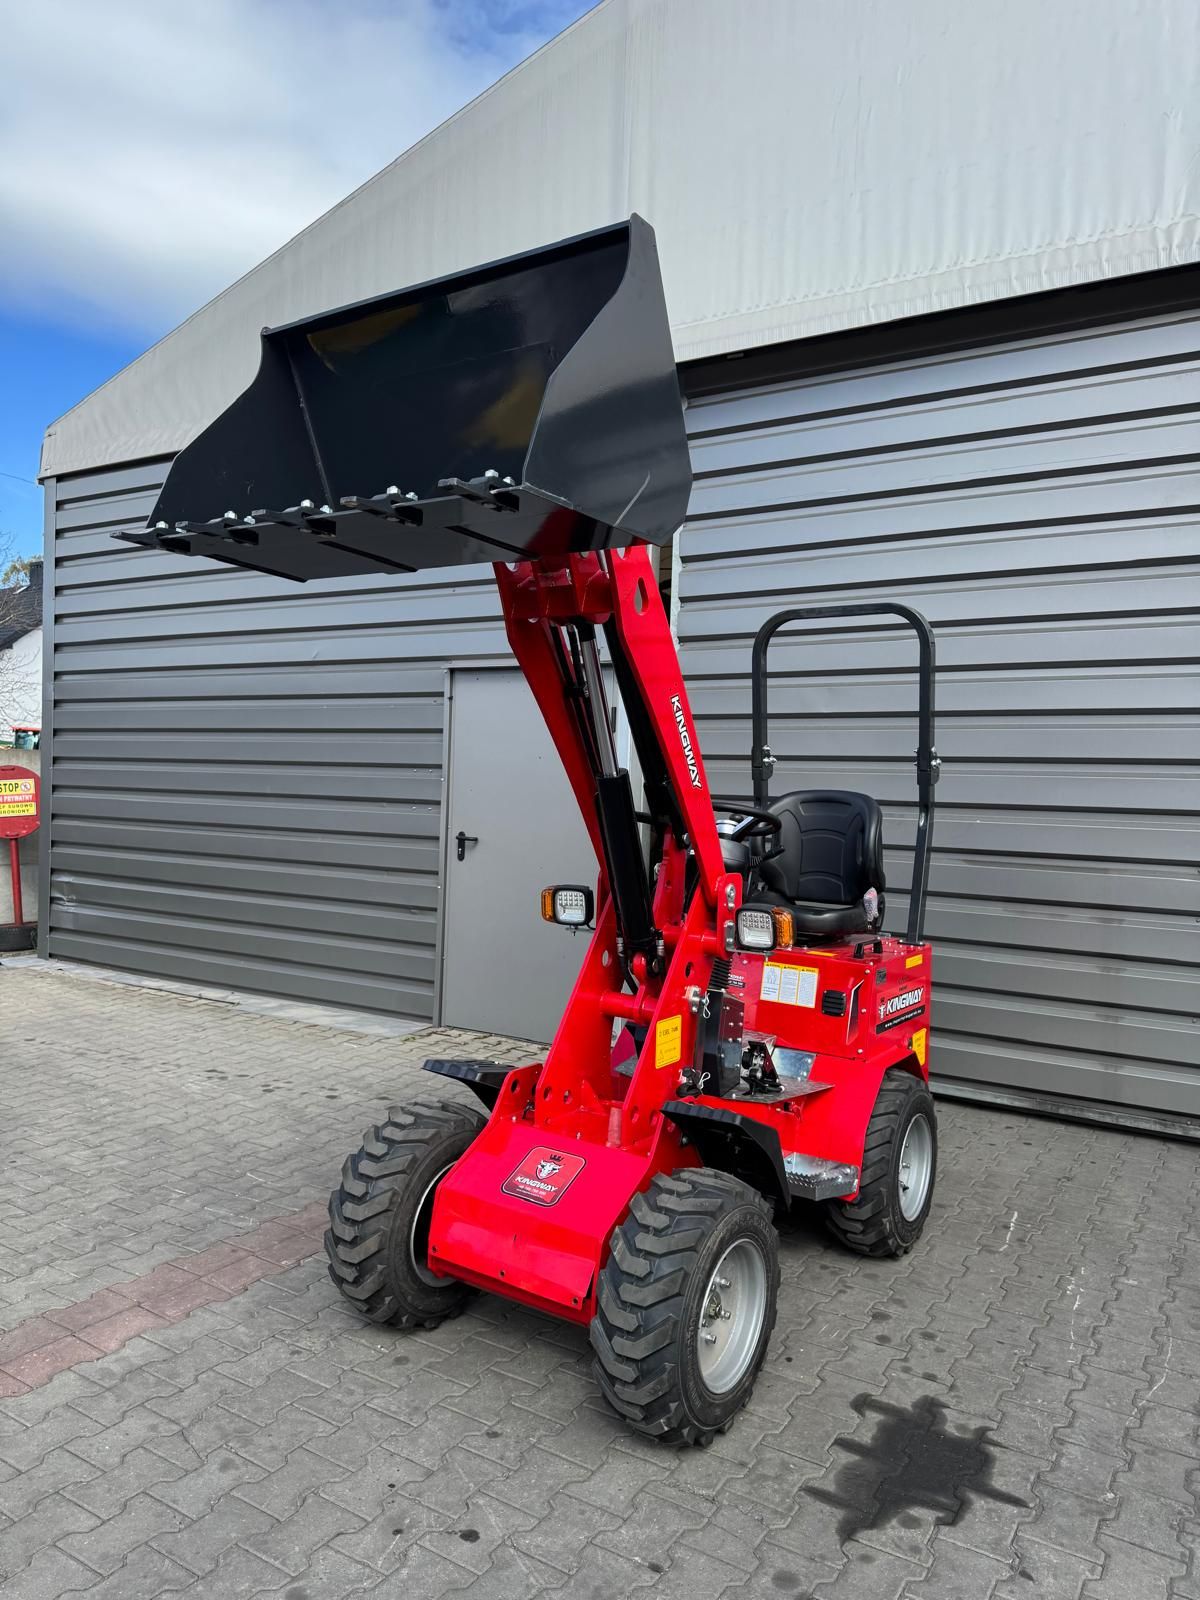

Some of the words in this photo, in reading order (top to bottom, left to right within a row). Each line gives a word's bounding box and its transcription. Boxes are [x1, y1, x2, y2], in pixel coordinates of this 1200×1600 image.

[671, 695, 702, 788] KINGWAY
[886, 987, 924, 1015] KINGWAY
[515, 1176, 558, 1192] KINGWAY
